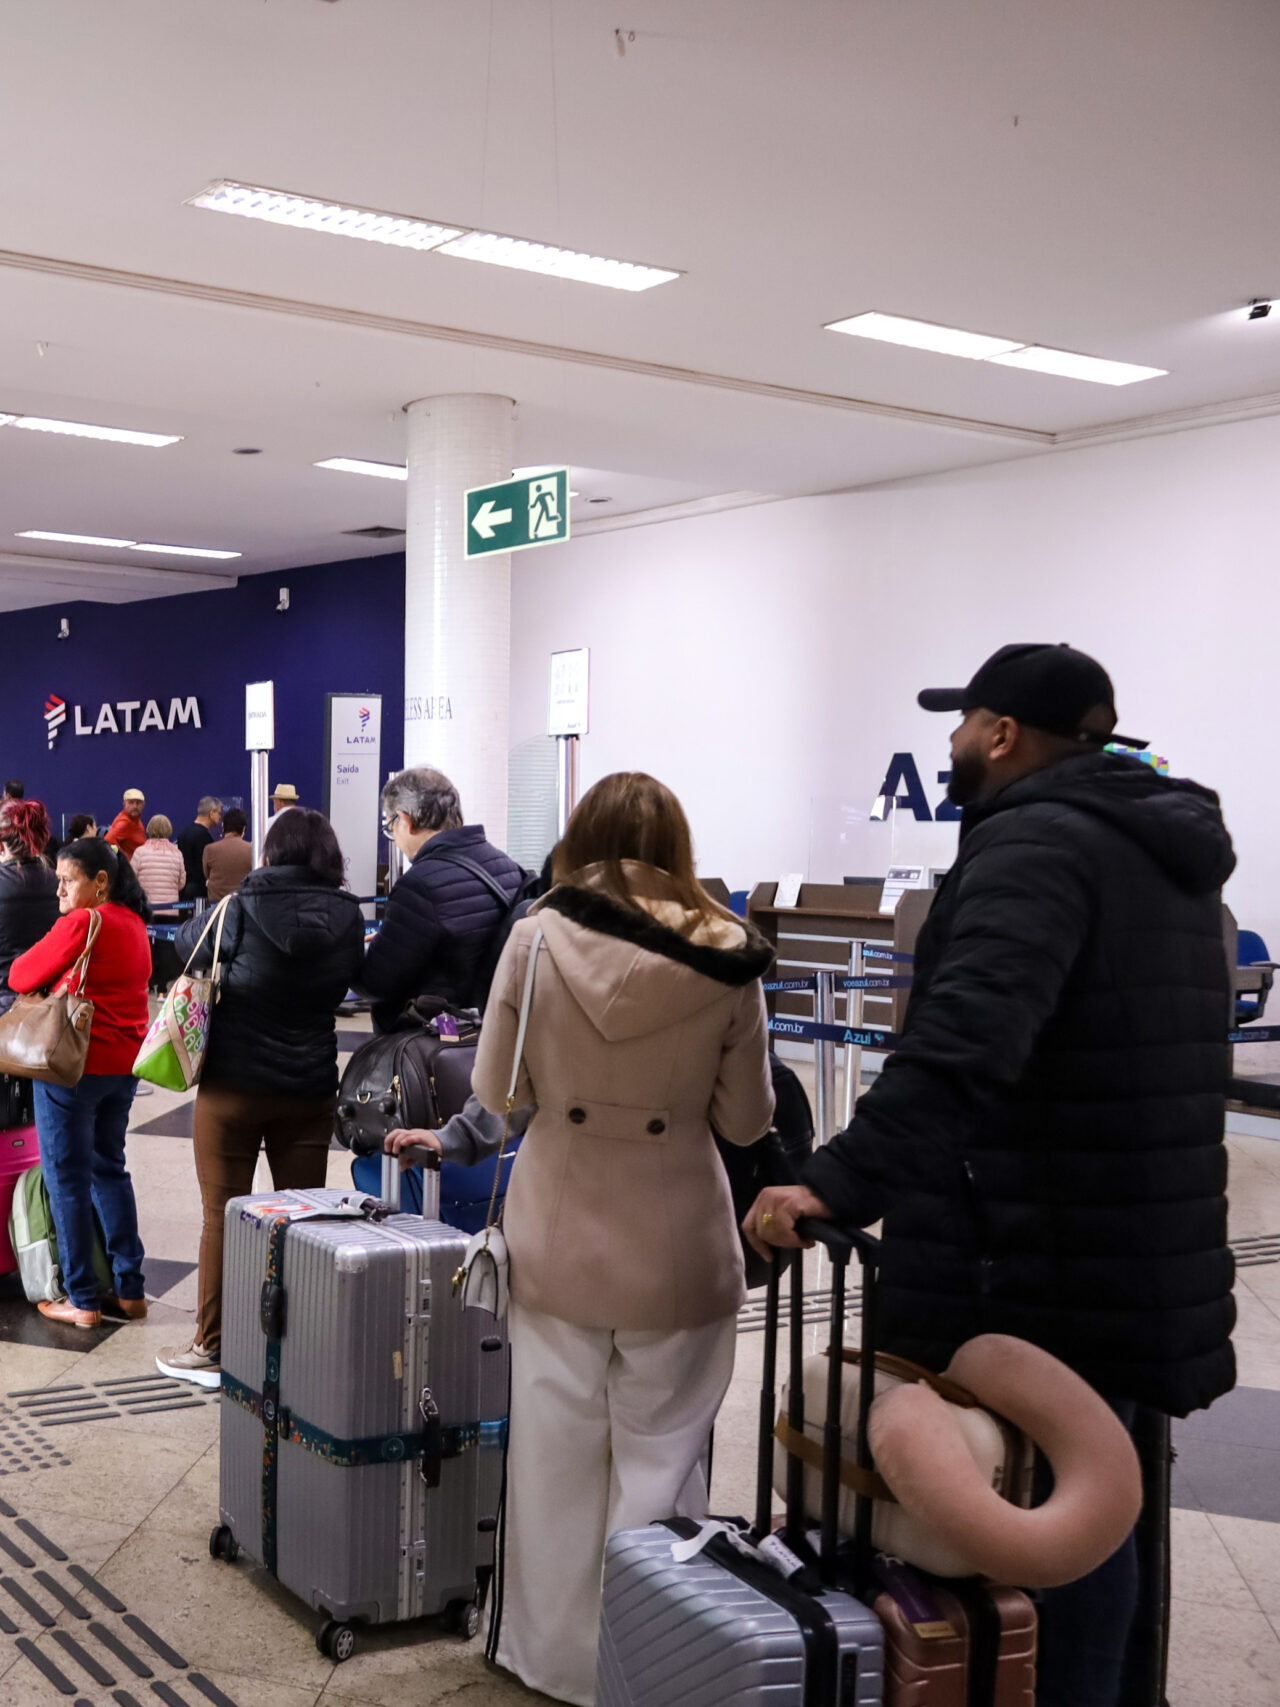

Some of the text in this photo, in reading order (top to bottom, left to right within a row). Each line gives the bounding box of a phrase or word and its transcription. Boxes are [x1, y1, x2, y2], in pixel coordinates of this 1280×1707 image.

[74, 696, 202, 736] LATAM
[346, 736, 376, 744] LATAM
[336, 777, 349, 785] Exit
[843, 978, 890, 988] voeazul.com.br
[843, 1029, 871, 1045] Azul
